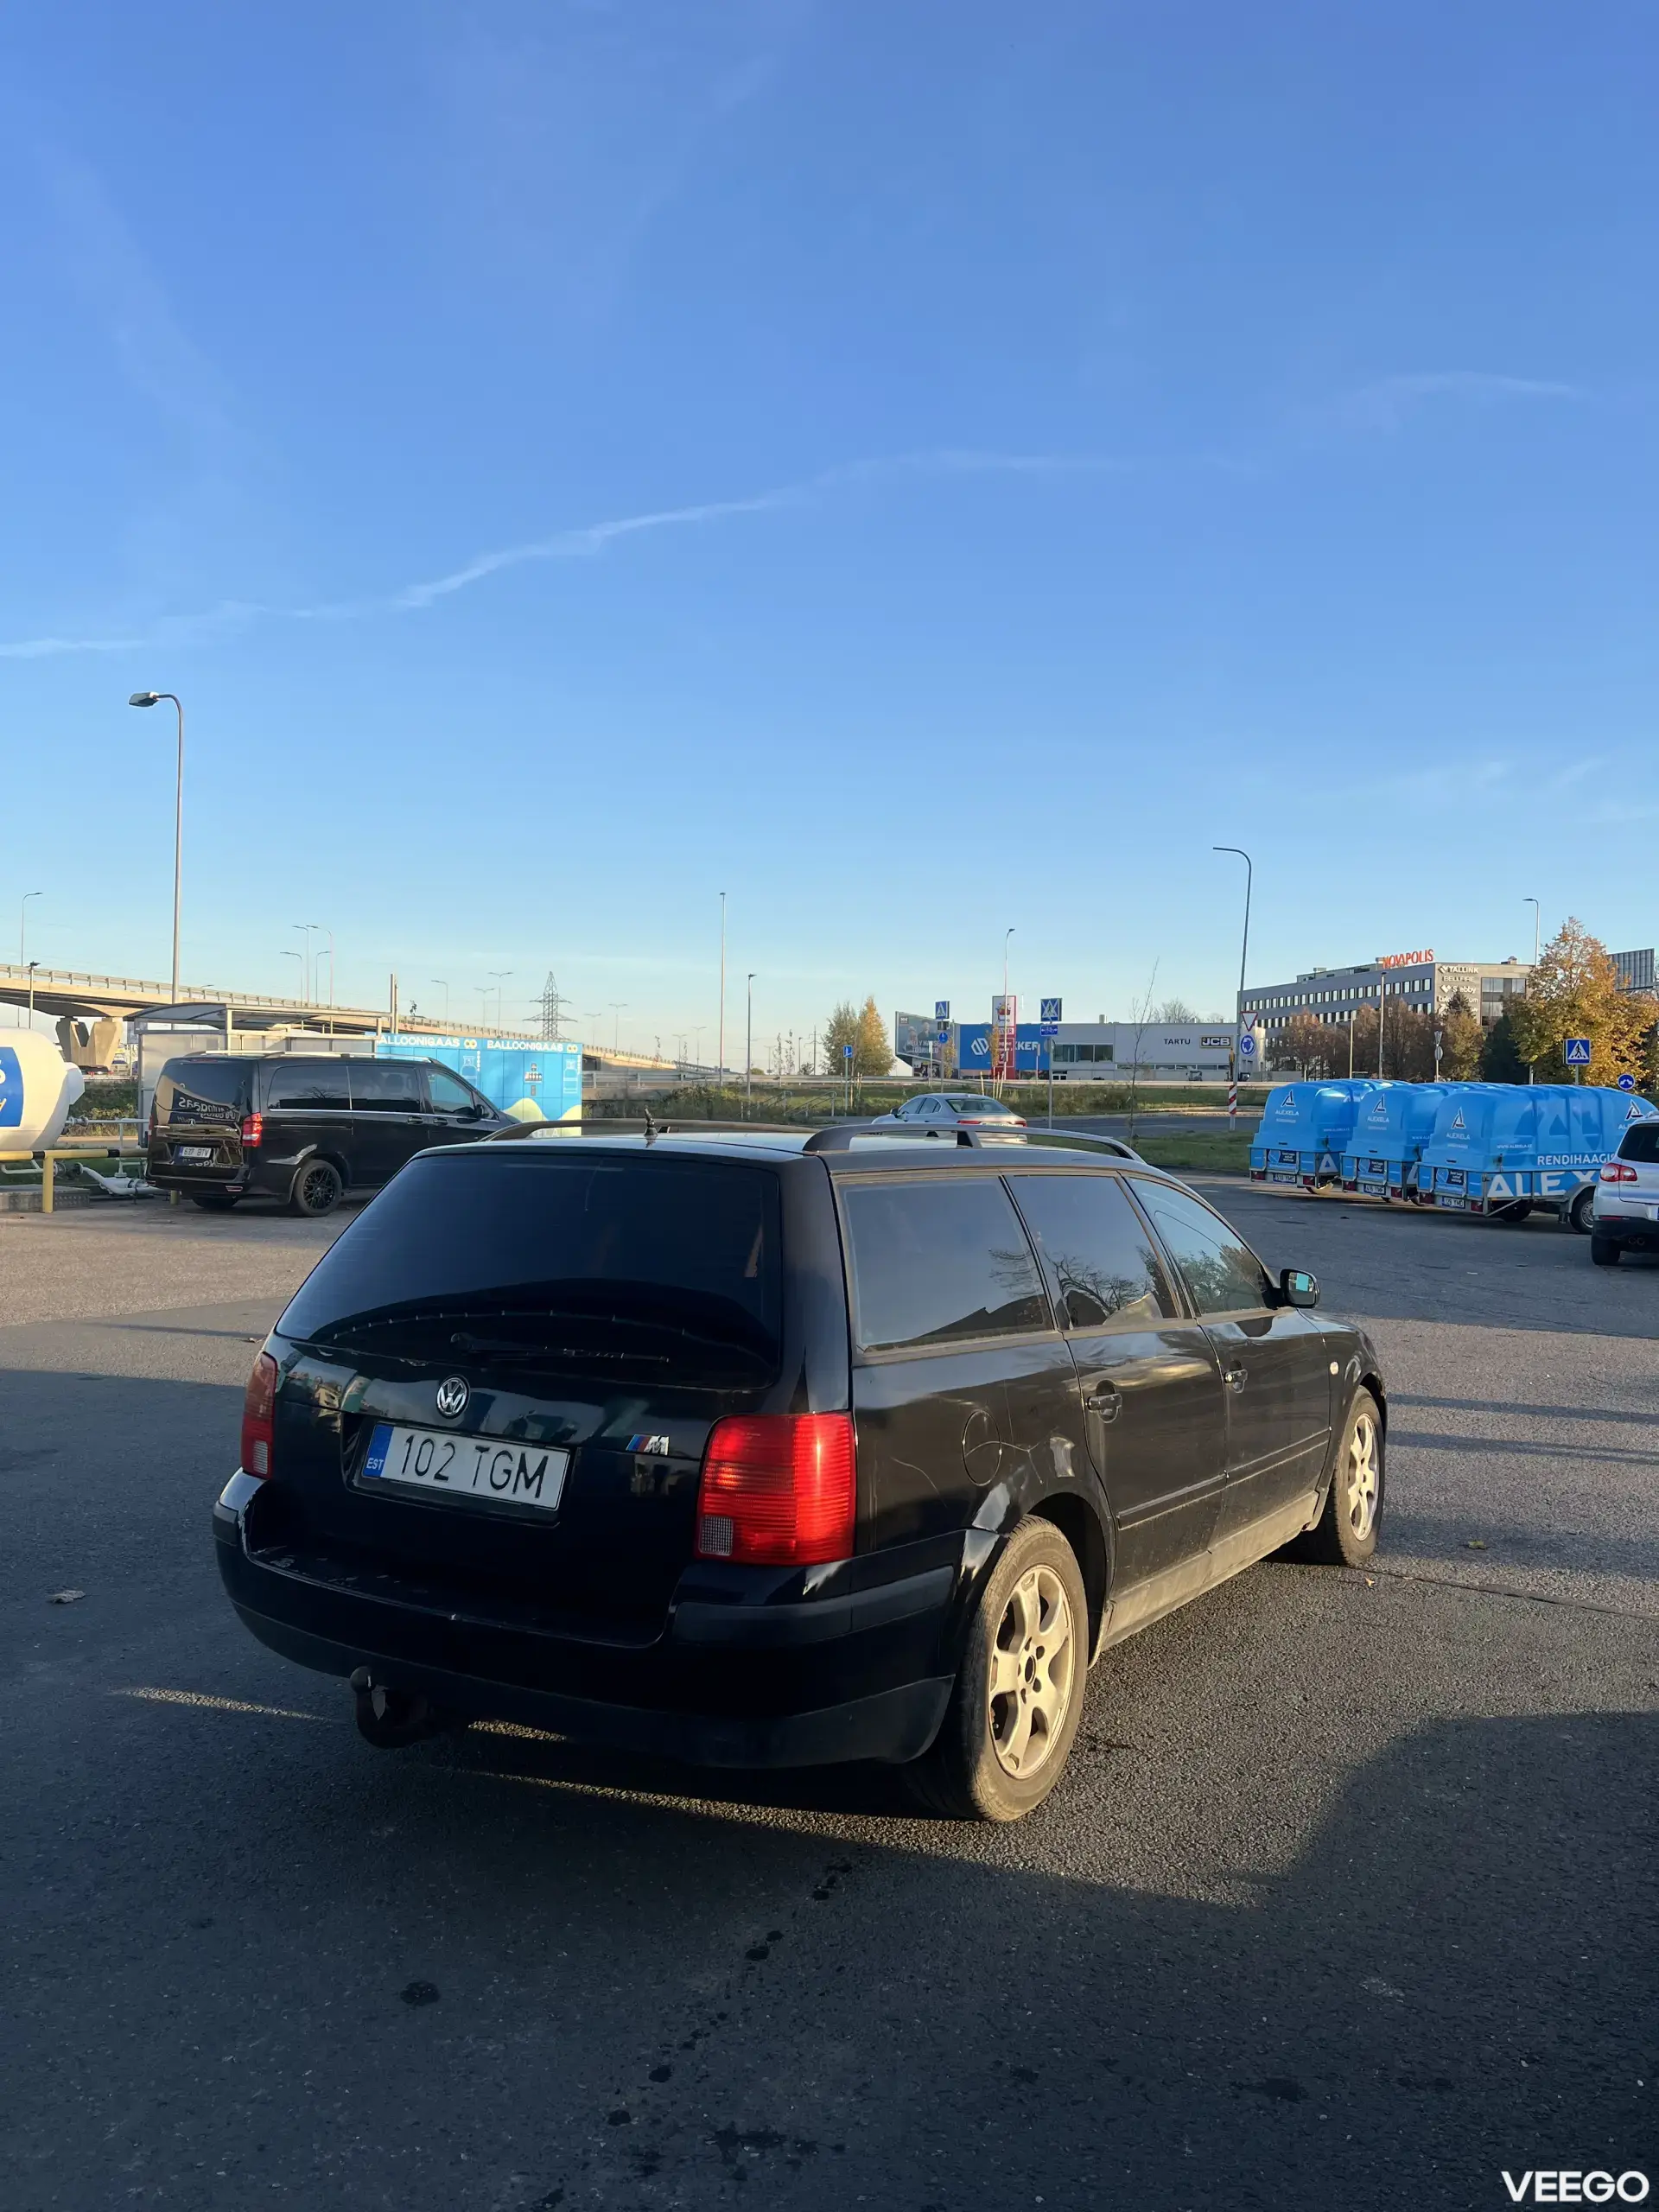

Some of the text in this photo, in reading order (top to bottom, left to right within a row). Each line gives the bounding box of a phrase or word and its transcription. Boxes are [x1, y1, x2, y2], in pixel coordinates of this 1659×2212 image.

[1382, 949, 1433, 968] NOVAPOLIS
[378, 1035, 461, 1047] ALLOONIGAAS
[487, 1039, 563, 1052] BALLOONIGAAS
[1202, 1037, 1230, 1046] JCB
[1446, 1132, 1471, 1141] ALEXELA
[365, 1433, 549, 1499] EST 102 TGM
